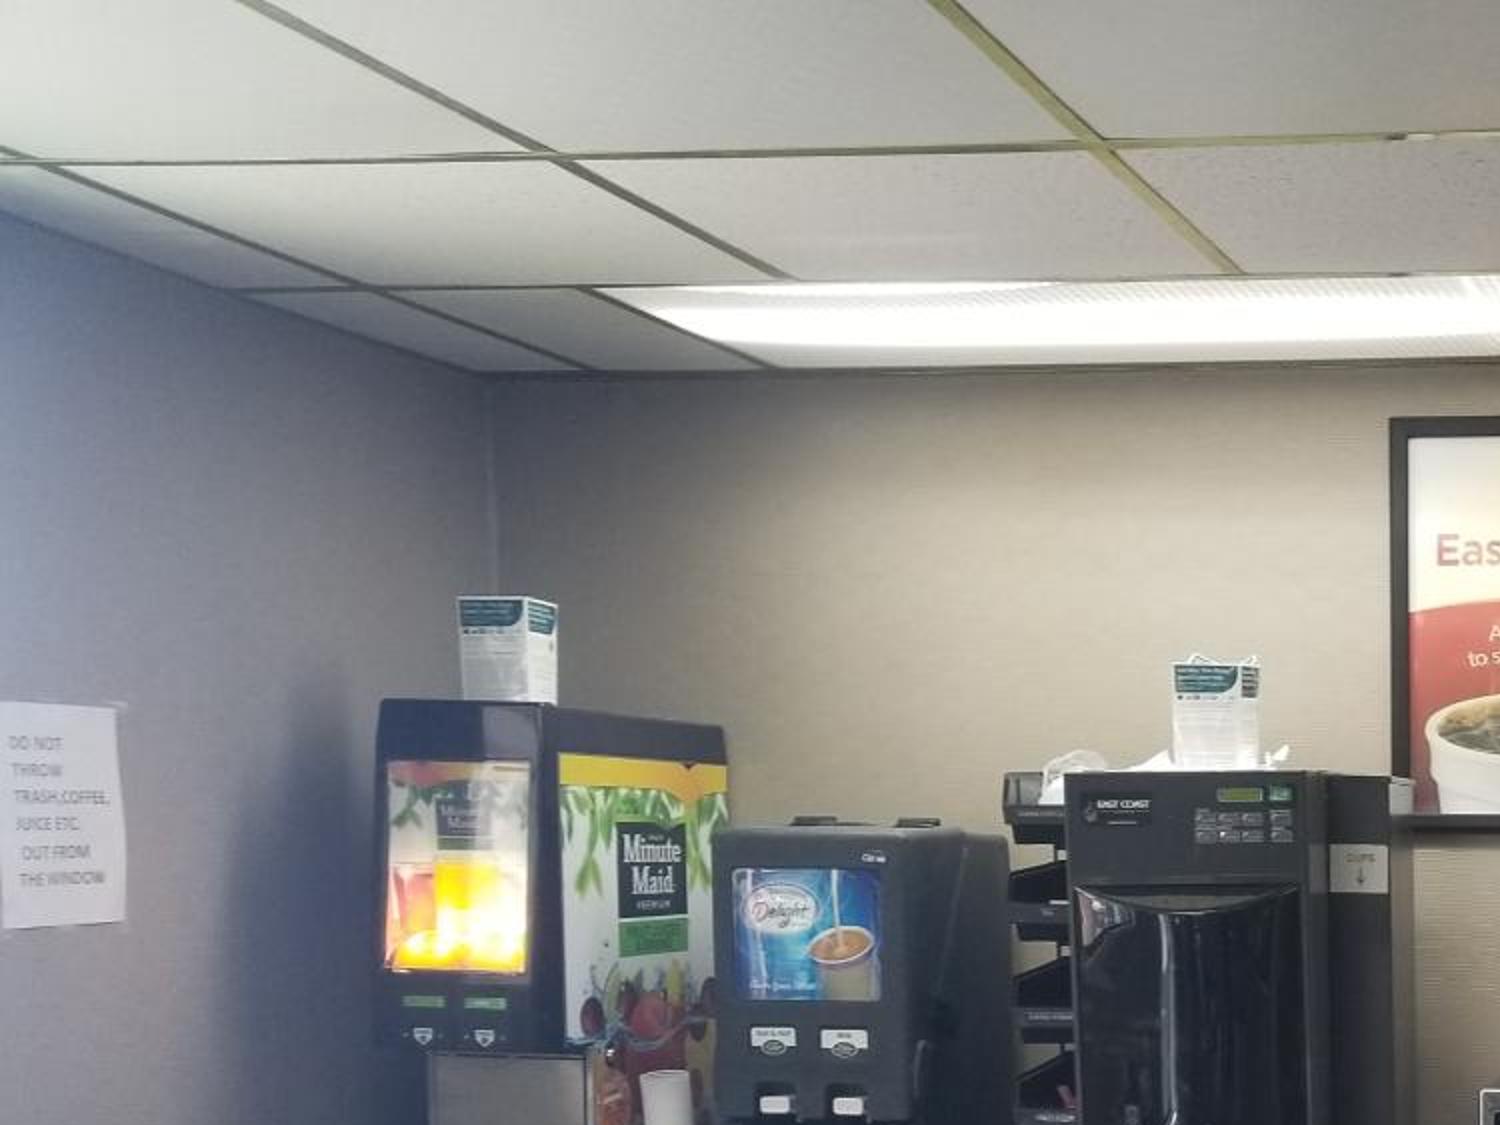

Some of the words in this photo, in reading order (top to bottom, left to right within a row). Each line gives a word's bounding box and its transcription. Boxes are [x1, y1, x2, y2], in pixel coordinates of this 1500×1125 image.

[1467, 651, 1488, 667] to
[8, 735, 29, 750] DO
[33, 735, 64, 750] NOT
[21, 846, 48, 861] OUT
[622, 833, 682, 863] Minute
[19, 872, 45, 887] THE
[631, 865, 675, 895] Maid
